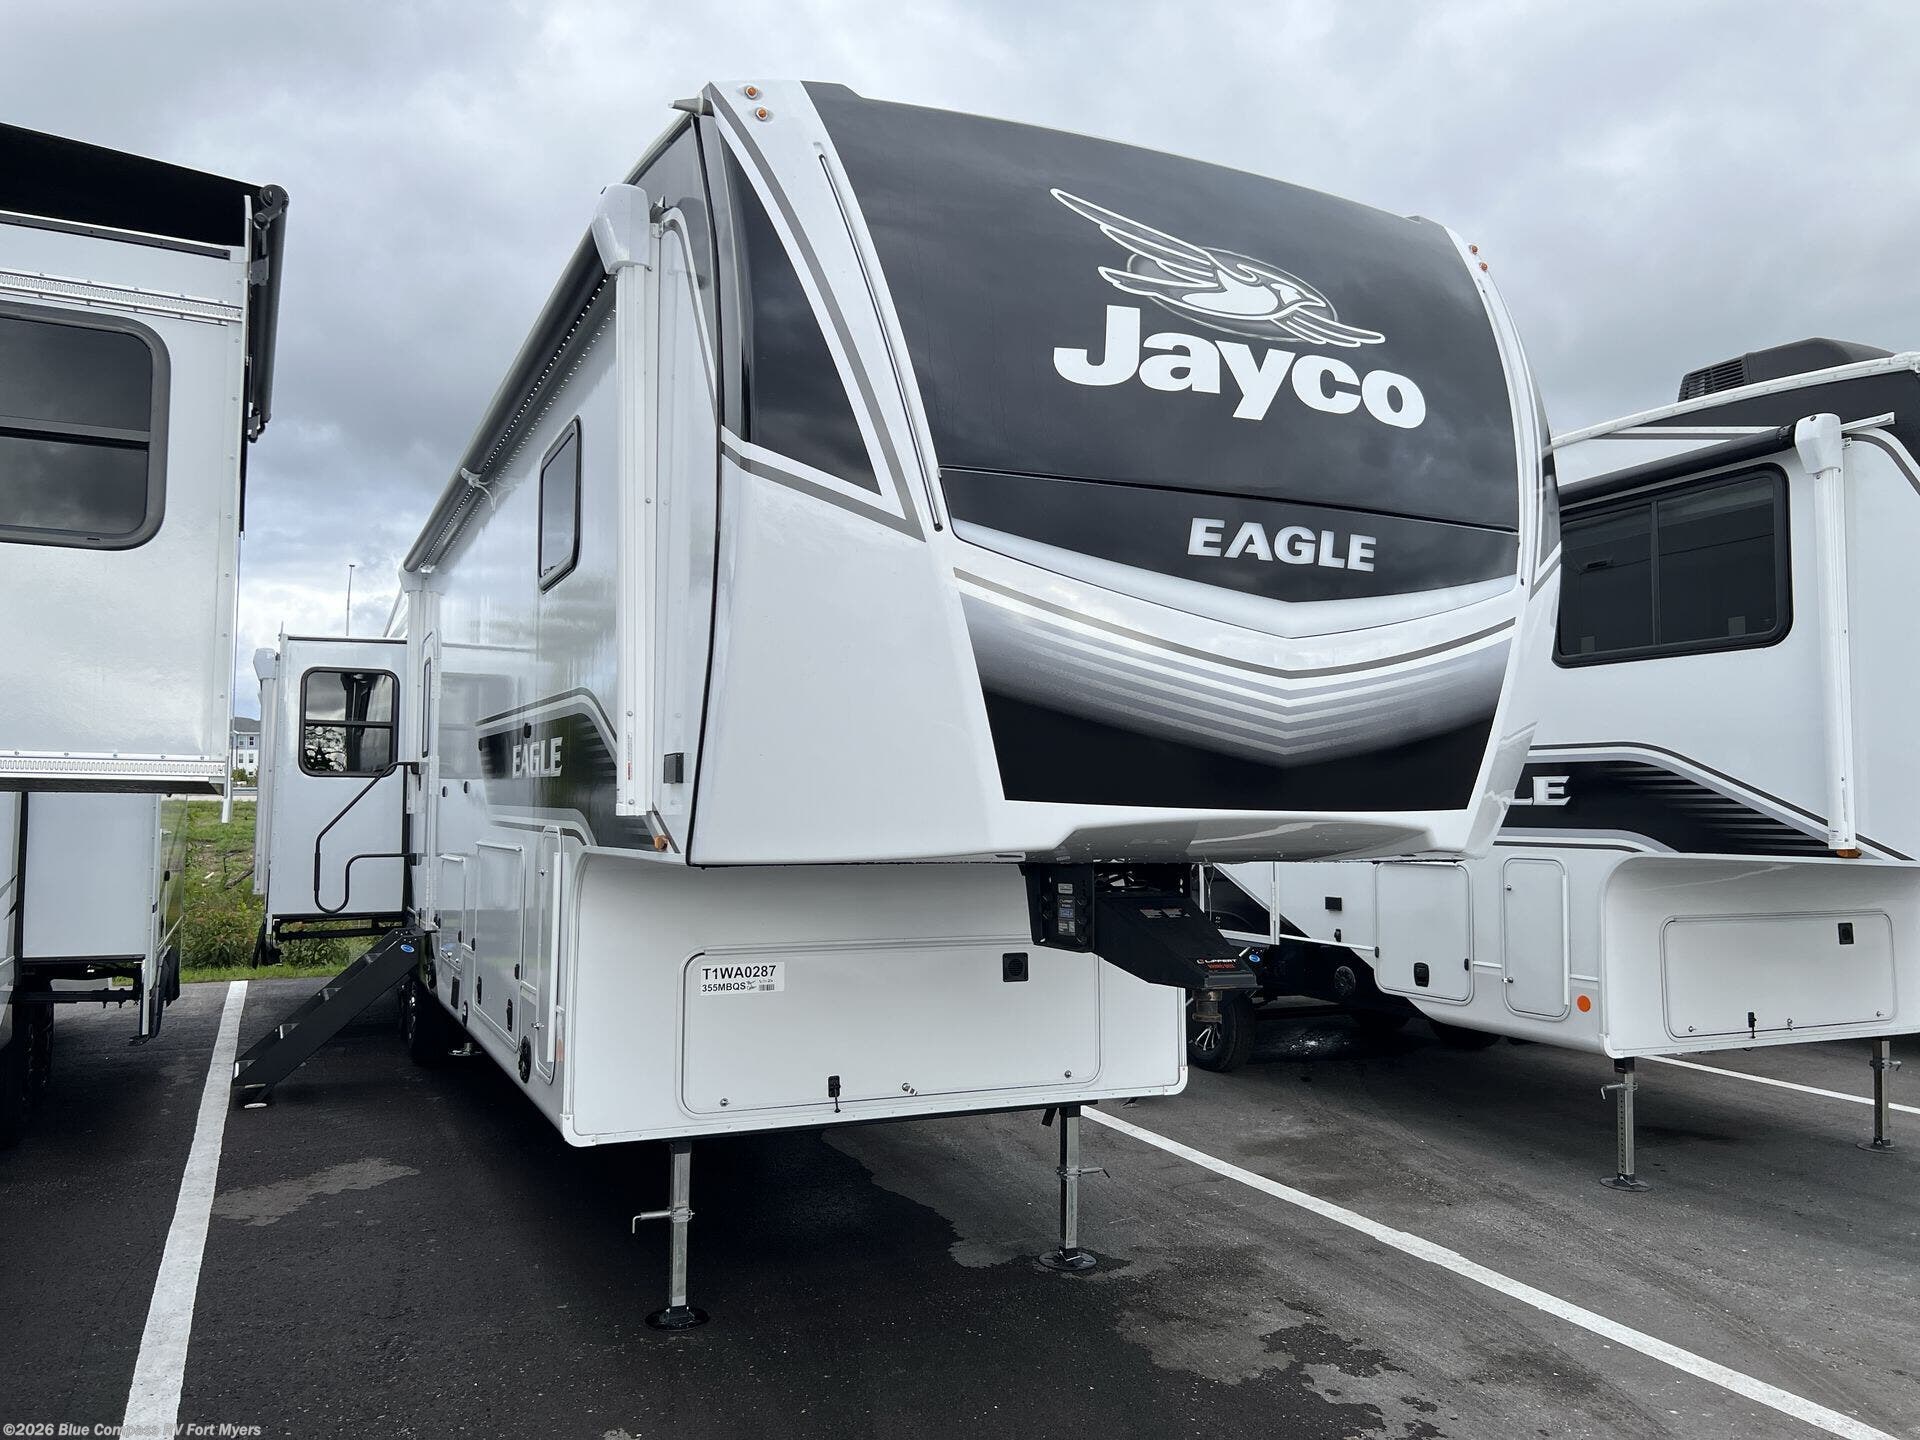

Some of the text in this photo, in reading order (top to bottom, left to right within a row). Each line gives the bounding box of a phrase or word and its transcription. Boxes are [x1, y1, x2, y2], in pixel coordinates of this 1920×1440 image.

[1053, 304, 1426, 429] Jayco
[1187, 517, 1377, 572] EAGLE
[512, 736, 563, 779] EAGLE
[702, 965, 777, 980] T1WA0287
[702, 981, 746, 992] 355MBQS
